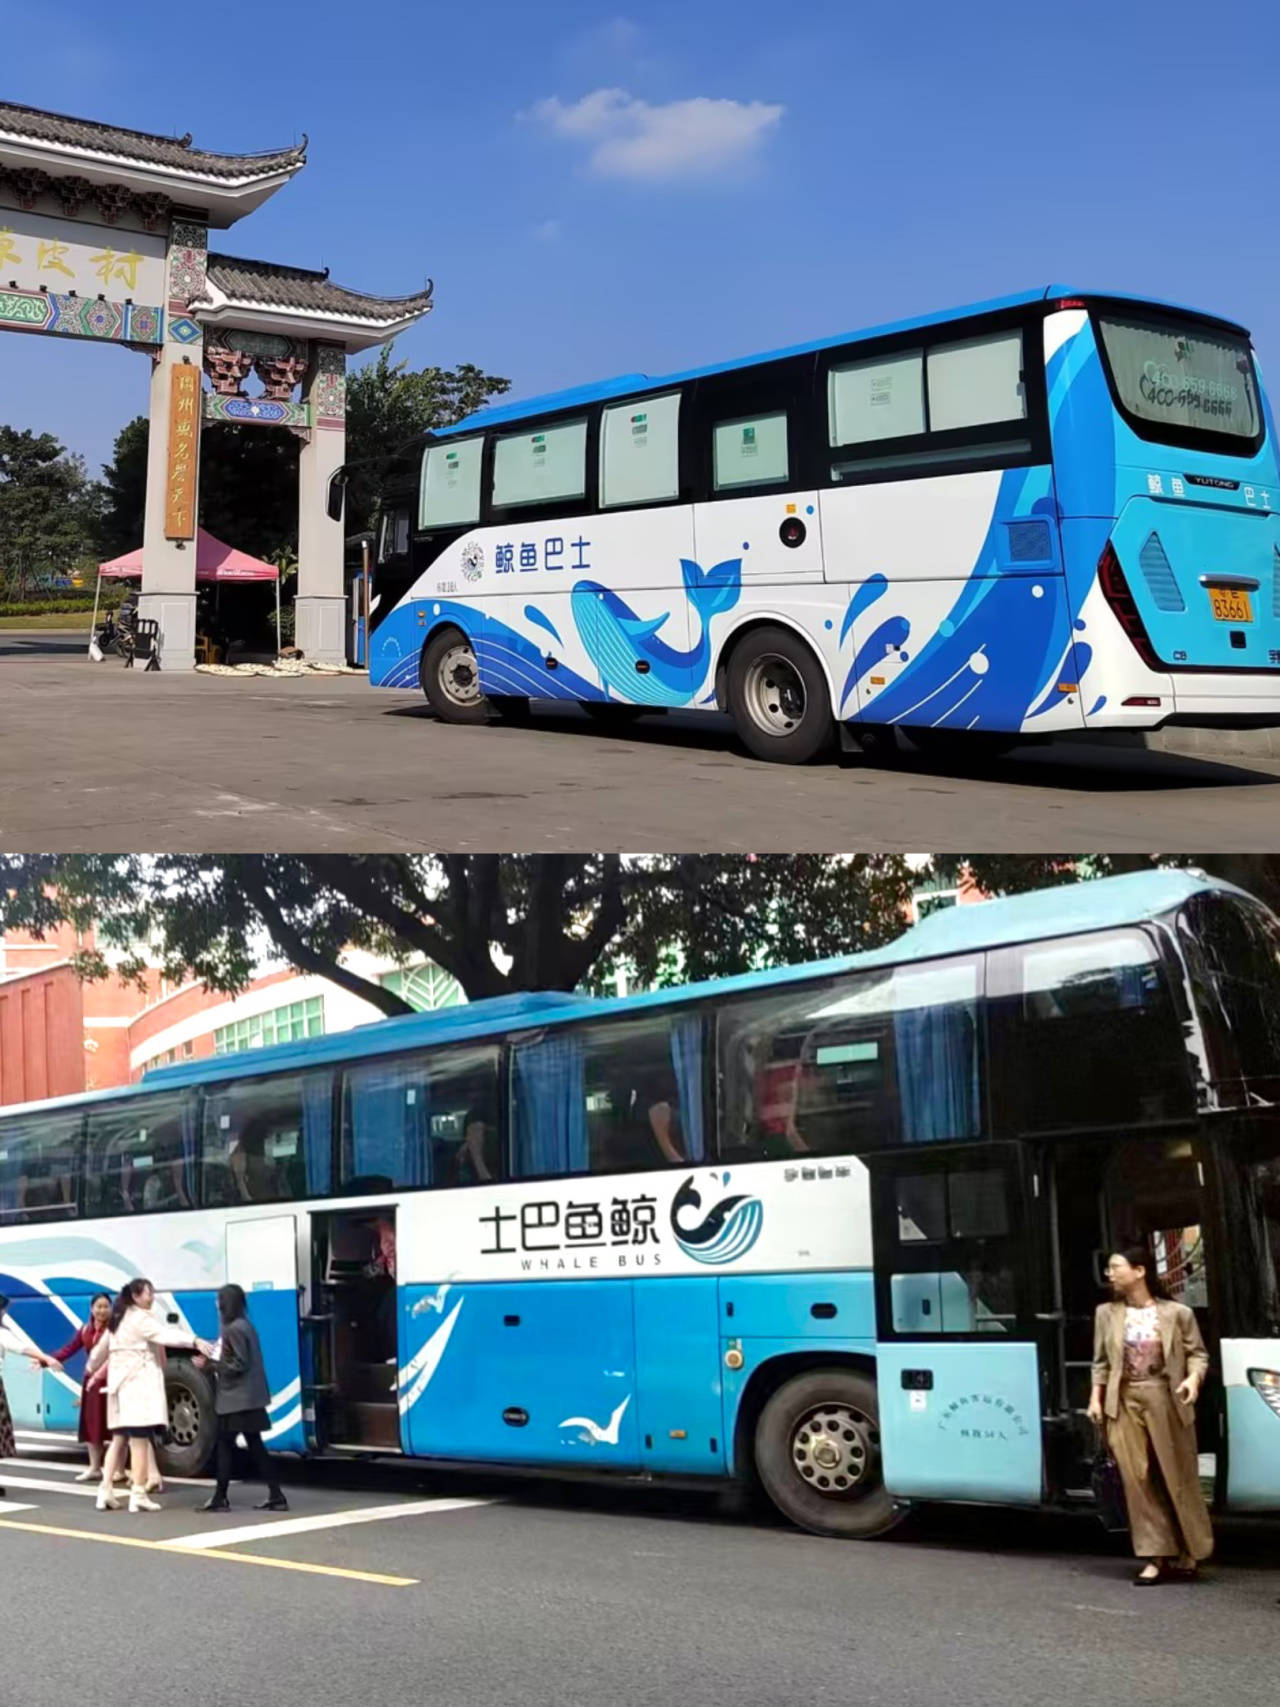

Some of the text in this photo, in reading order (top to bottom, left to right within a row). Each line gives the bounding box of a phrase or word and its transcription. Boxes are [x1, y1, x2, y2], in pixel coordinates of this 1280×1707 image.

[495, 535, 592, 574] 鲸鱼巴士
[1214, 599, 1249, 618] 83661
[521, 1253, 662, 1271] WHALE BUS
